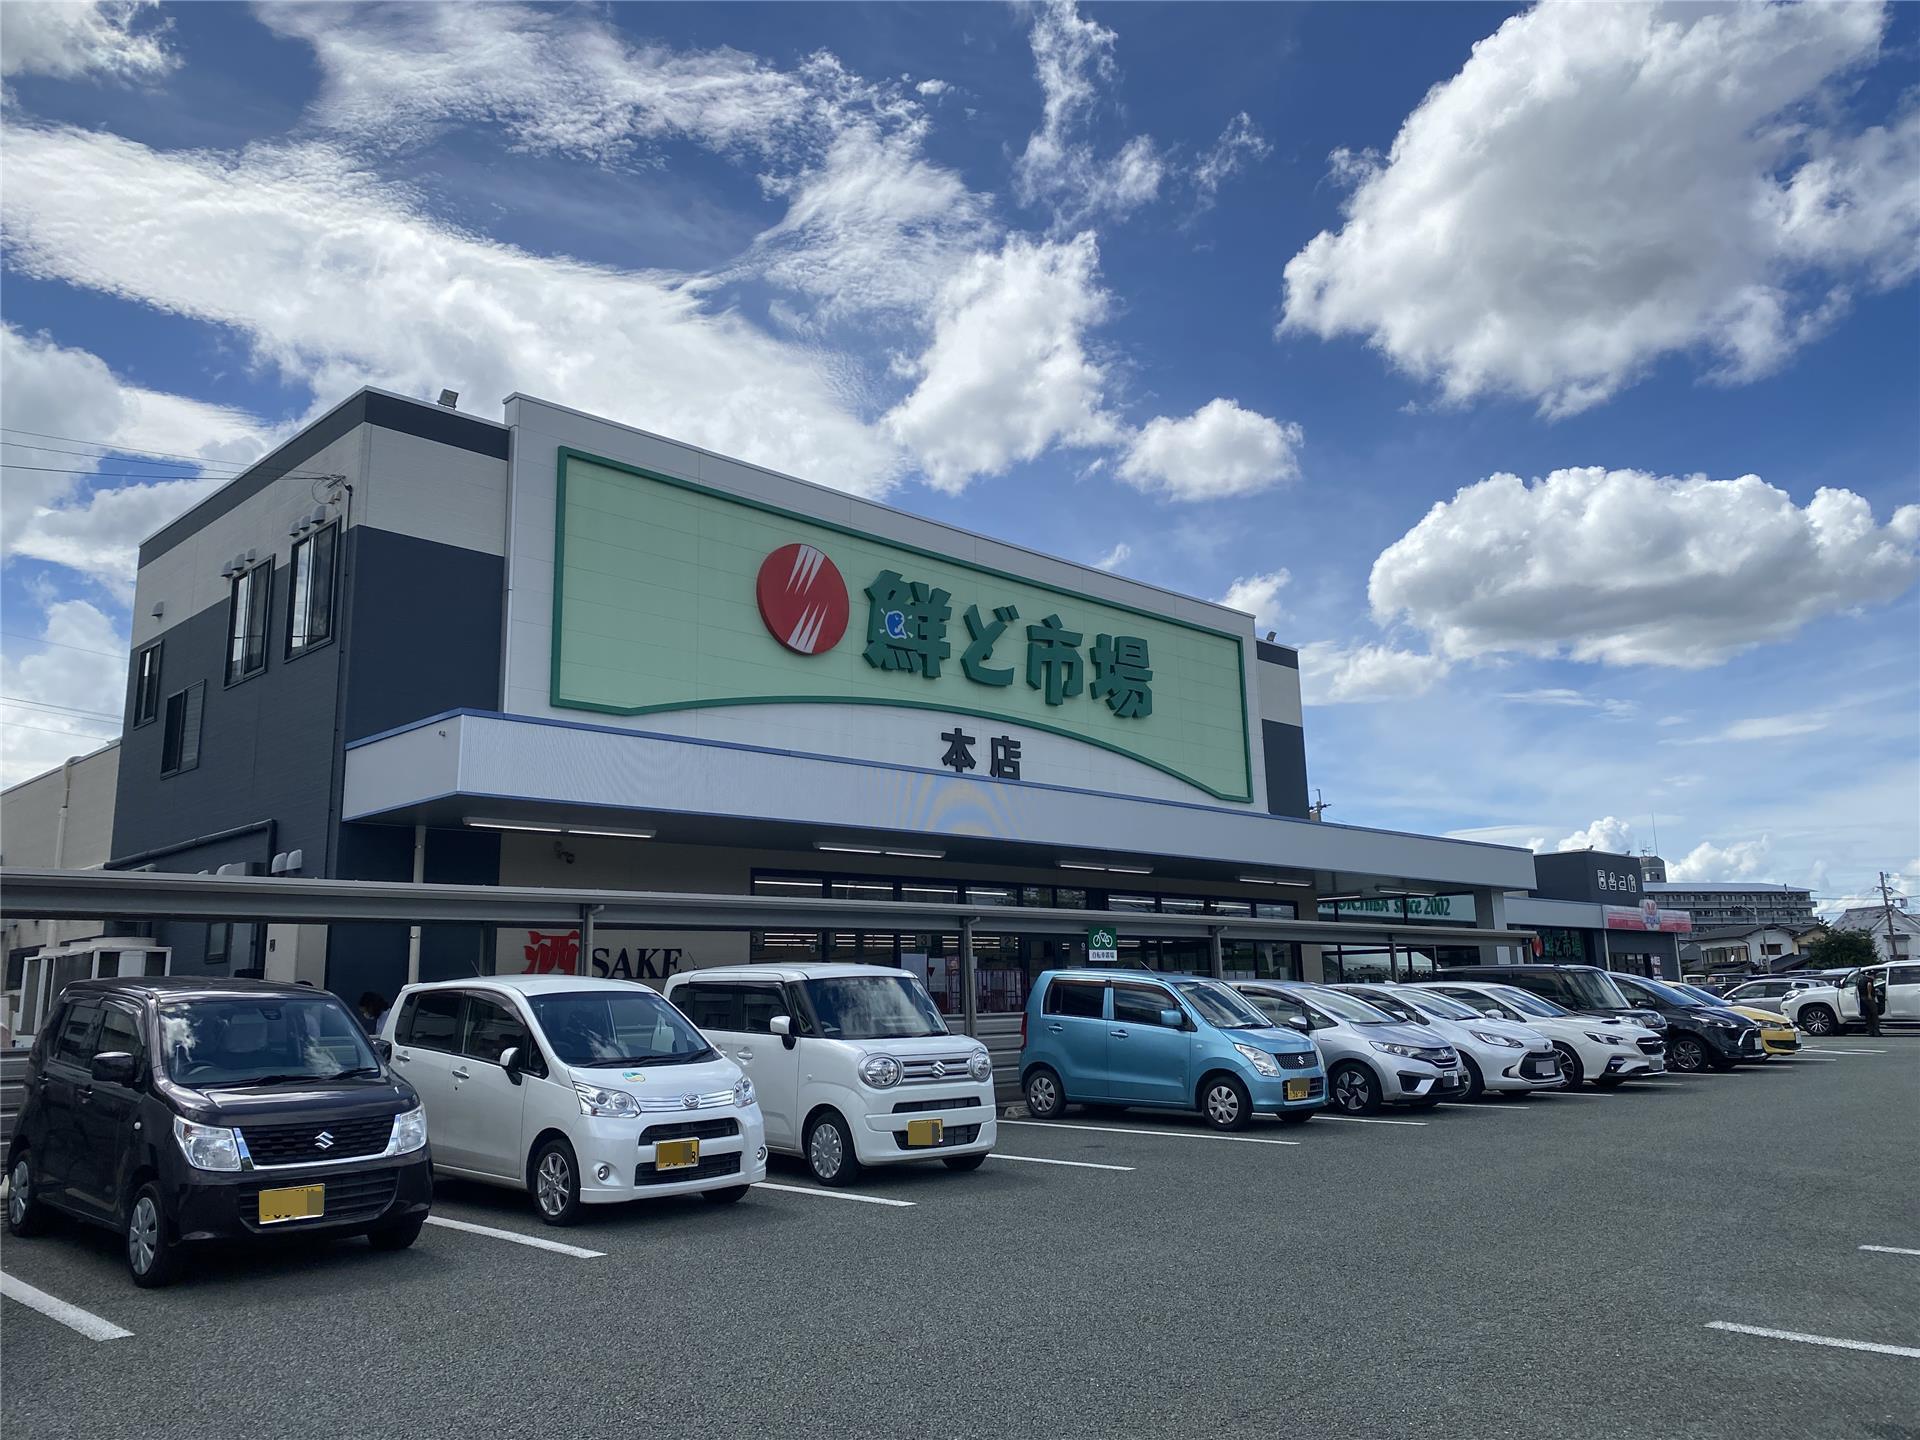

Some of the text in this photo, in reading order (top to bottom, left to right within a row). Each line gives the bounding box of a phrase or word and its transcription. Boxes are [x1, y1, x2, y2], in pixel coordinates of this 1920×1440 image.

[863, 569, 1153, 718] 鮮ど市場
[941, 727, 1021, 780] 本店
[1424, 898, 1450, 915] 2002
[592, 947, 683, 979] SAKE
